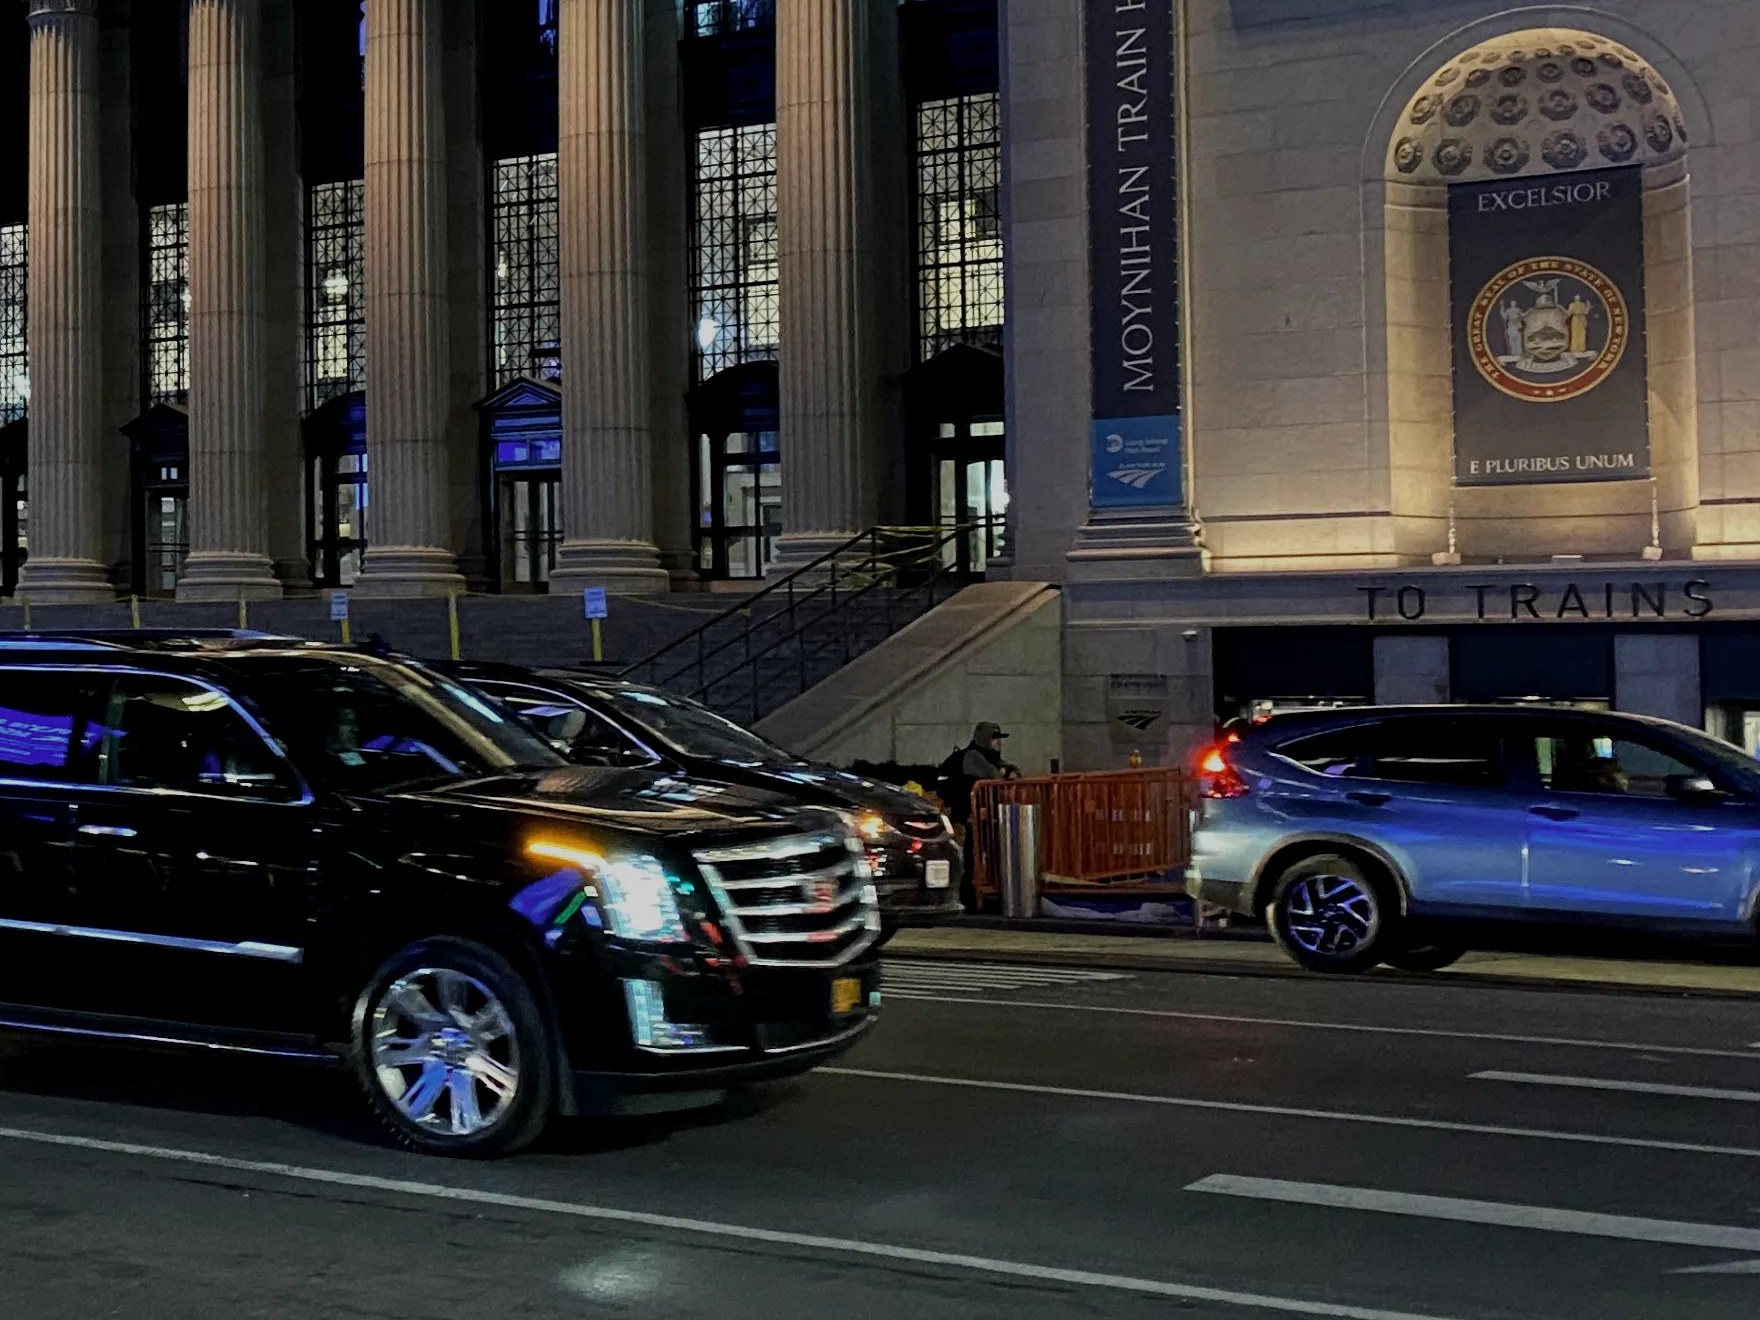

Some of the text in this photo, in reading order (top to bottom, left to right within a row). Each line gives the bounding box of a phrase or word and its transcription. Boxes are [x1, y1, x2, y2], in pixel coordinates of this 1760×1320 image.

[1114, 27, 1149, 151] TRAIN
[1477, 181, 1611, 213] EXCELSIOR
[1119, 164, 1154, 393] MOYNIHAN
[1469, 453, 1634, 475] E PLURIBUS UNUM
[1357, 580, 1715, 624] TO TRAINS
